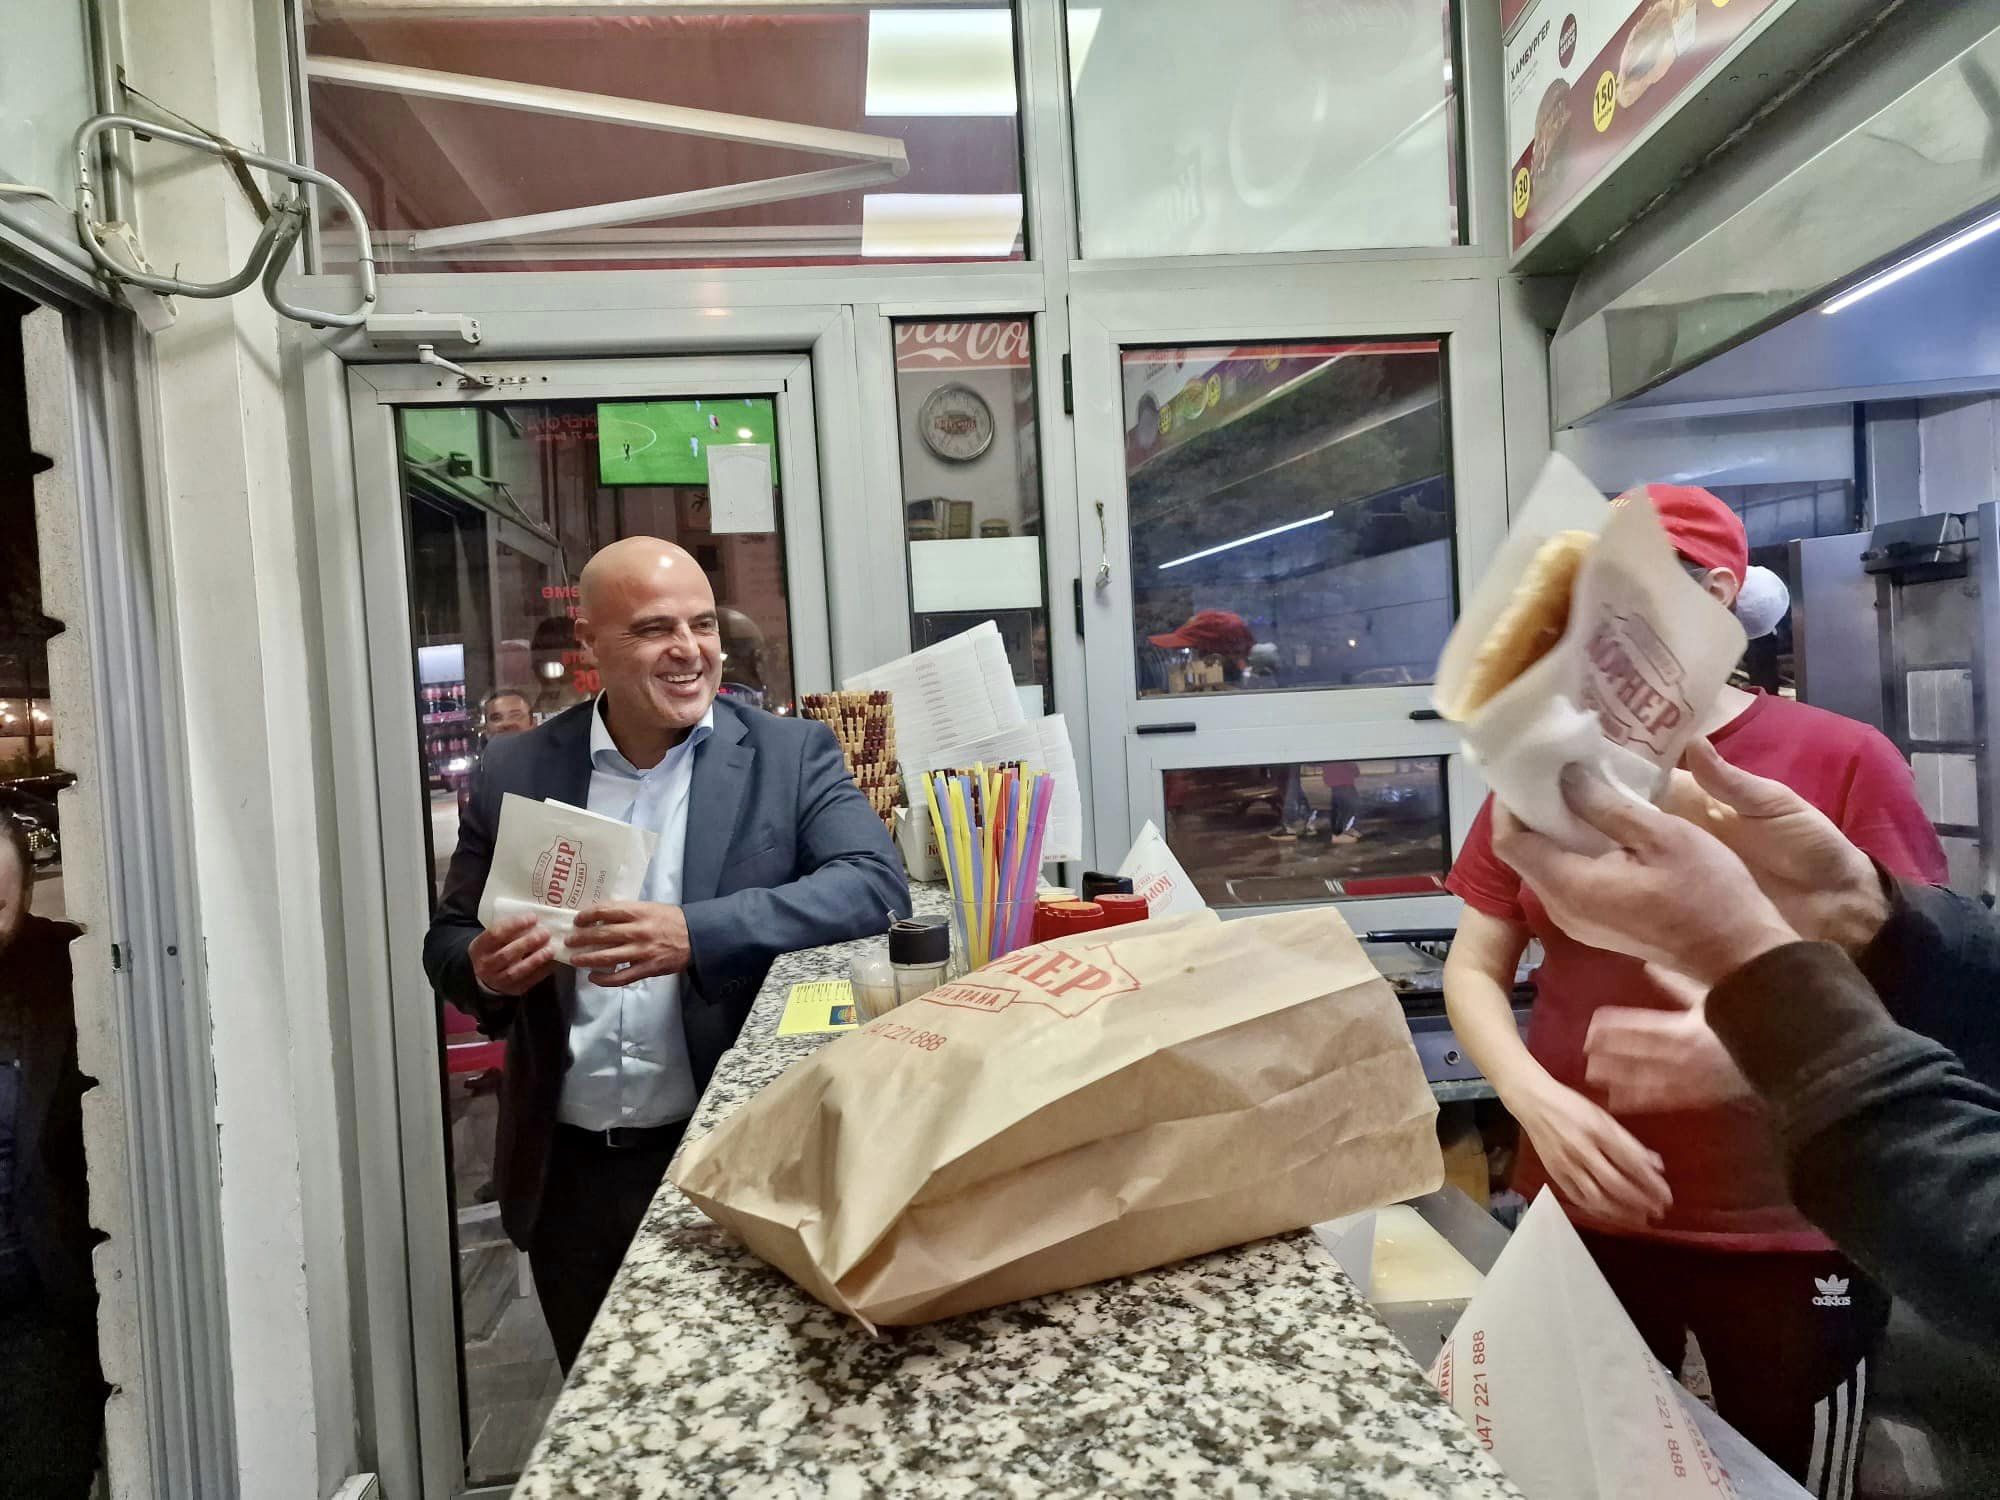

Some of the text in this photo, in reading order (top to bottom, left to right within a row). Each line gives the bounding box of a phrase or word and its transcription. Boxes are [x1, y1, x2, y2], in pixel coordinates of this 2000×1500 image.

[1511, 20, 1550, 80] ХАМБУРГЕР
[1596, 78, 1614, 113] 150
[1514, 175, 1528, 198] 130
[545, 842, 575, 907] ОРНЕР
[911, 1031, 948, 1051] 888
[1812, 1296, 1850, 1306] adidas
[1473, 1330, 1485, 1365] 888
[1474, 1373, 1489, 1406] 221
[1656, 1394, 1674, 1430] 221
[1668, 1438, 1687, 1478] 888
